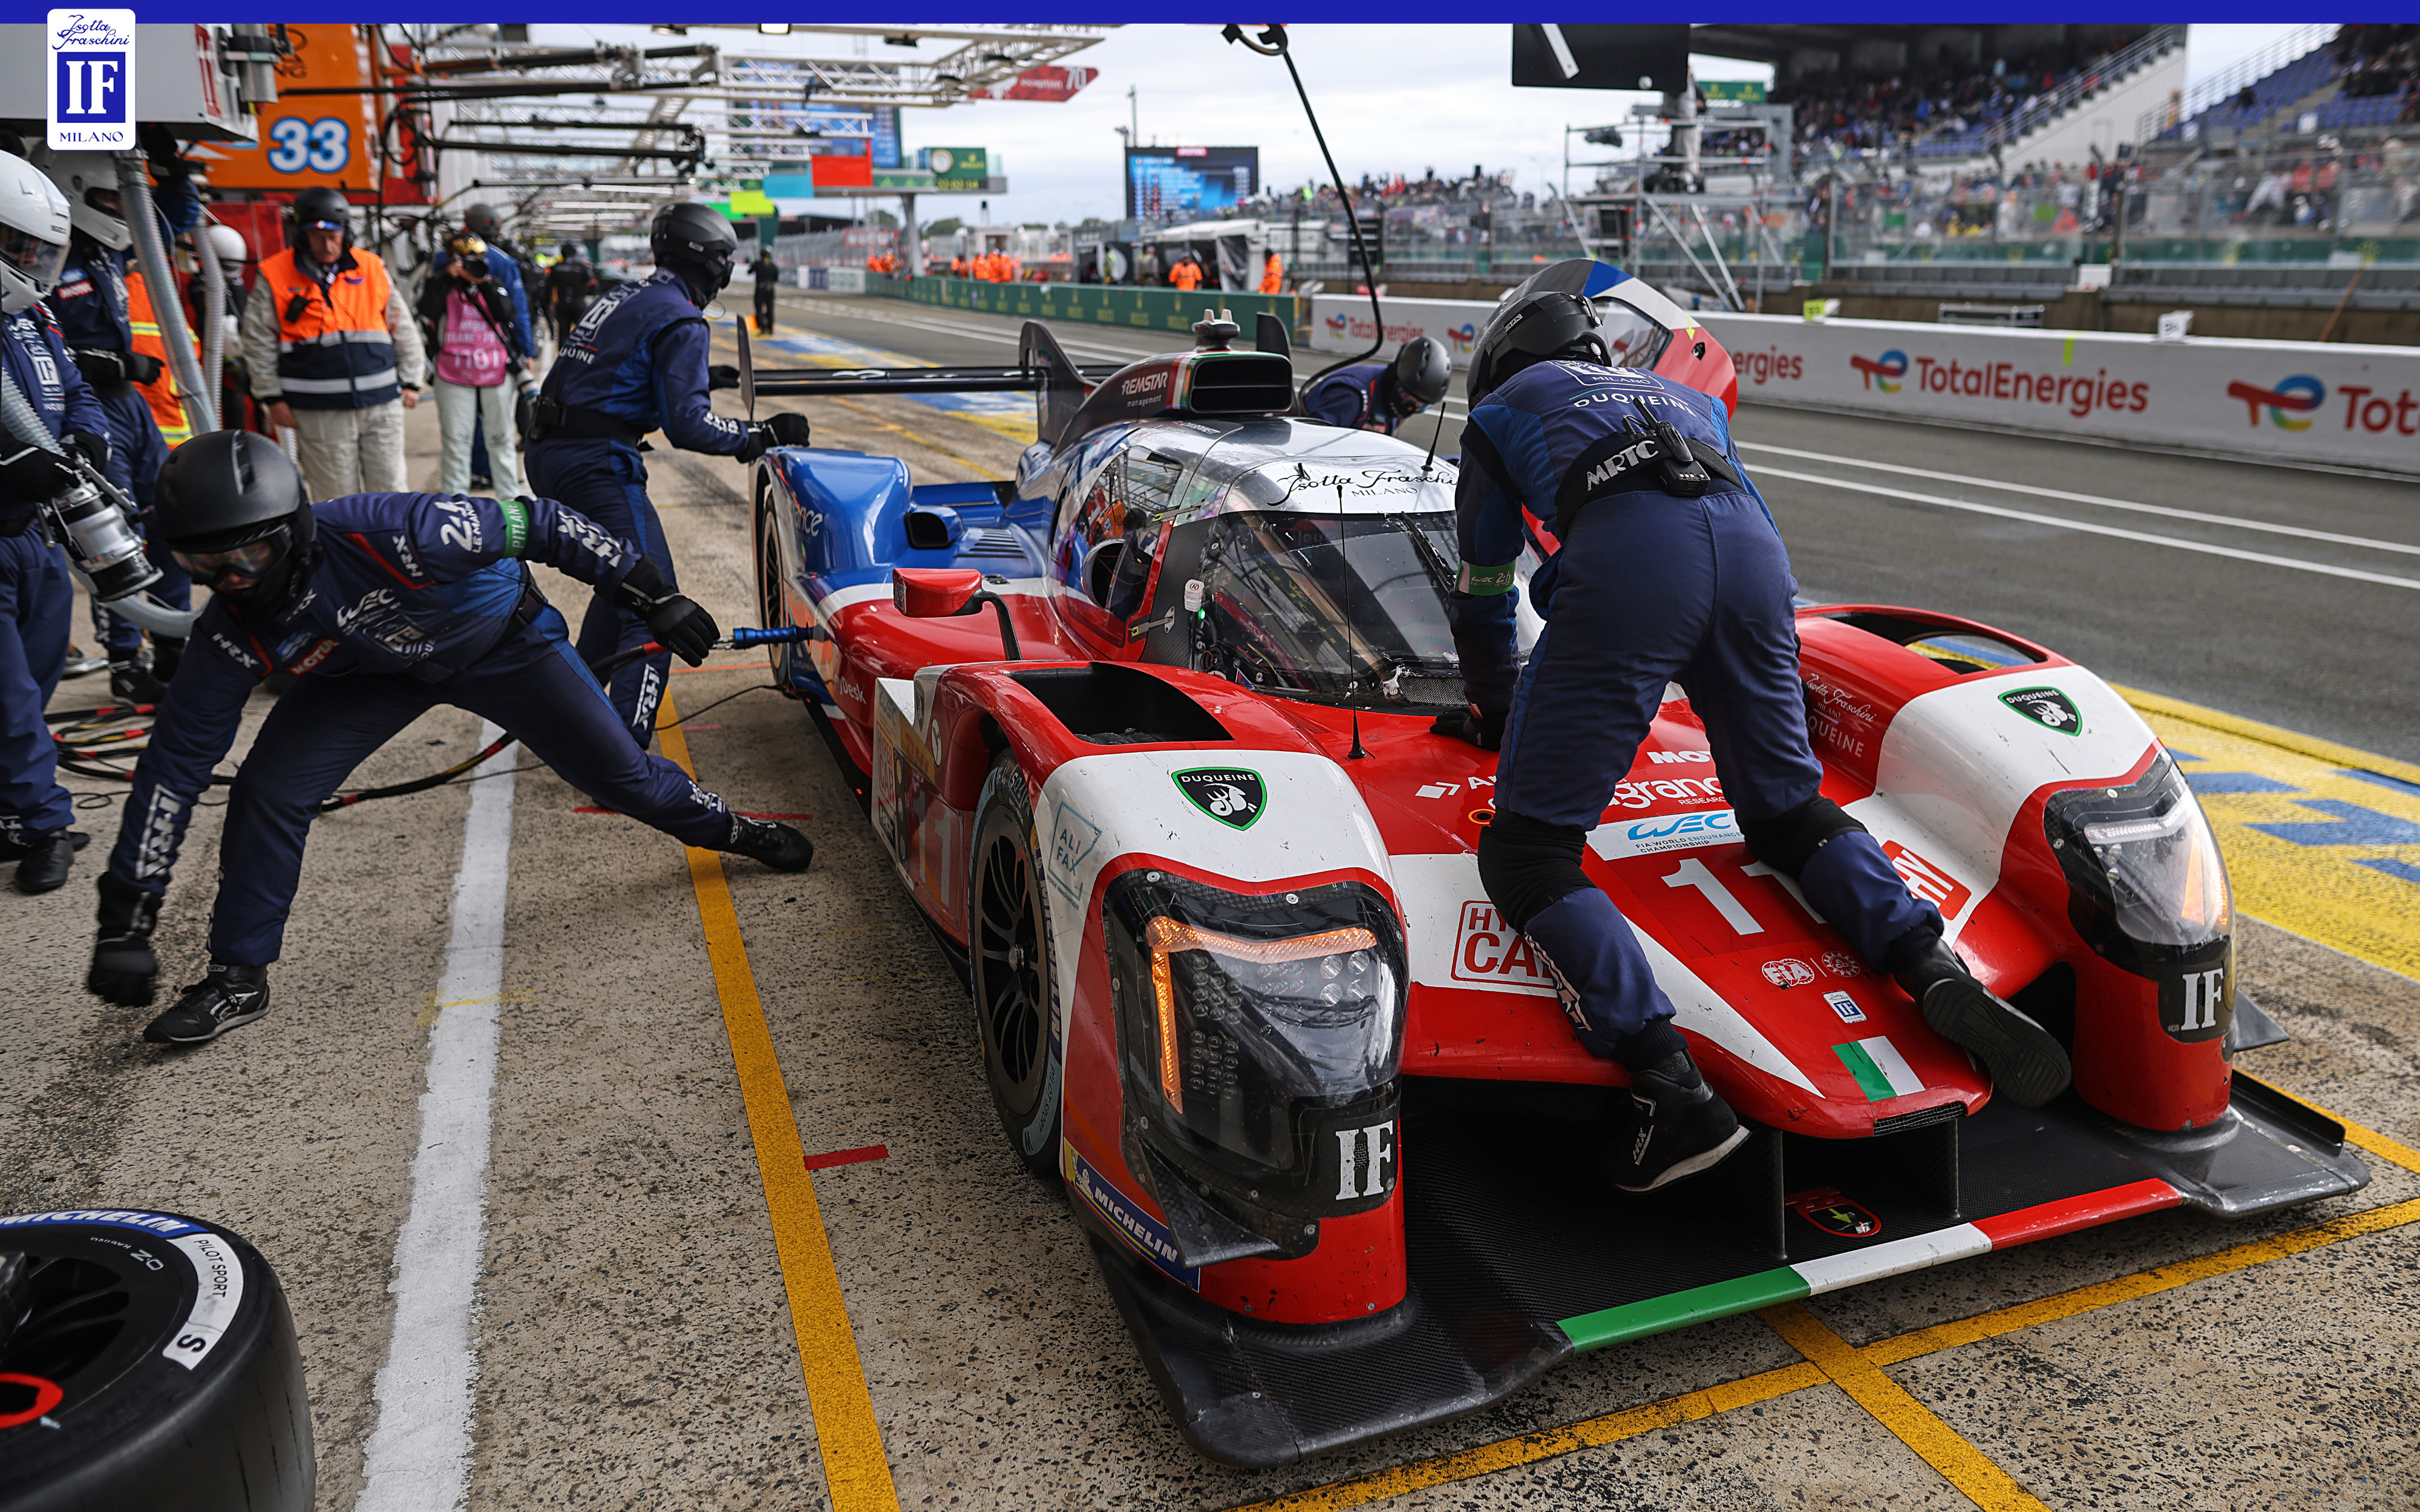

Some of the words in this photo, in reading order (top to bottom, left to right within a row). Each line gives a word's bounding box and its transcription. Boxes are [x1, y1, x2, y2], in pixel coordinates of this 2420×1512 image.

[1064, 67, 1087, 90] 70
[268, 117, 350, 174] 33
[1349, 318, 1425, 344] Totalnergies
[1121, 371, 1169, 396] REMSTAR
[1592, 376, 1651, 385] MILANO
[1915, 357, 2150, 419] TotalEnergies
[1127, 394, 1162, 408] management
[2337, 384, 2420, 437] Tot
[1586, 439, 1659, 491] MRTC
[1267, 473, 1353, 507] Isotta
[1350, 486, 1419, 498] MILANO
[511, 503, 526, 550] PITLANE
[472, 533, 482, 553] LE
[336, 587, 396, 628] WEC
[212, 633, 259, 669] HRX
[1817, 702, 1841, 719] MILANO
[1823, 688, 1877, 723] Fraschini
[2006, 688, 2060, 705] DUQUEINE
[879, 753, 895, 804] CAR
[1180, 772, 1257, 784] DUQUEINE
[1059, 827, 1081, 856] ALI
[1627, 813, 1731, 841] WEC
[1653, 838, 1687, 847] WORLD
[1689, 832, 1742, 842] ENDURANCE
[1640, 840, 1710, 853] CHAMPIONSHIP
[1056, 847, 1079, 876] FAX
[1836, 1002, 1856, 1016] IF
[2180, 968, 2224, 1031] IF
[1039, 1101, 1051, 1133] SPORT
[1335, 1120, 1394, 1201] IF
[1094, 1186, 1178, 1263] MICHELIN
[194, 1238, 219, 1263] PILOT
[211, 1262, 227, 1299] SPORT
[177, 1333, 207, 1354] S
